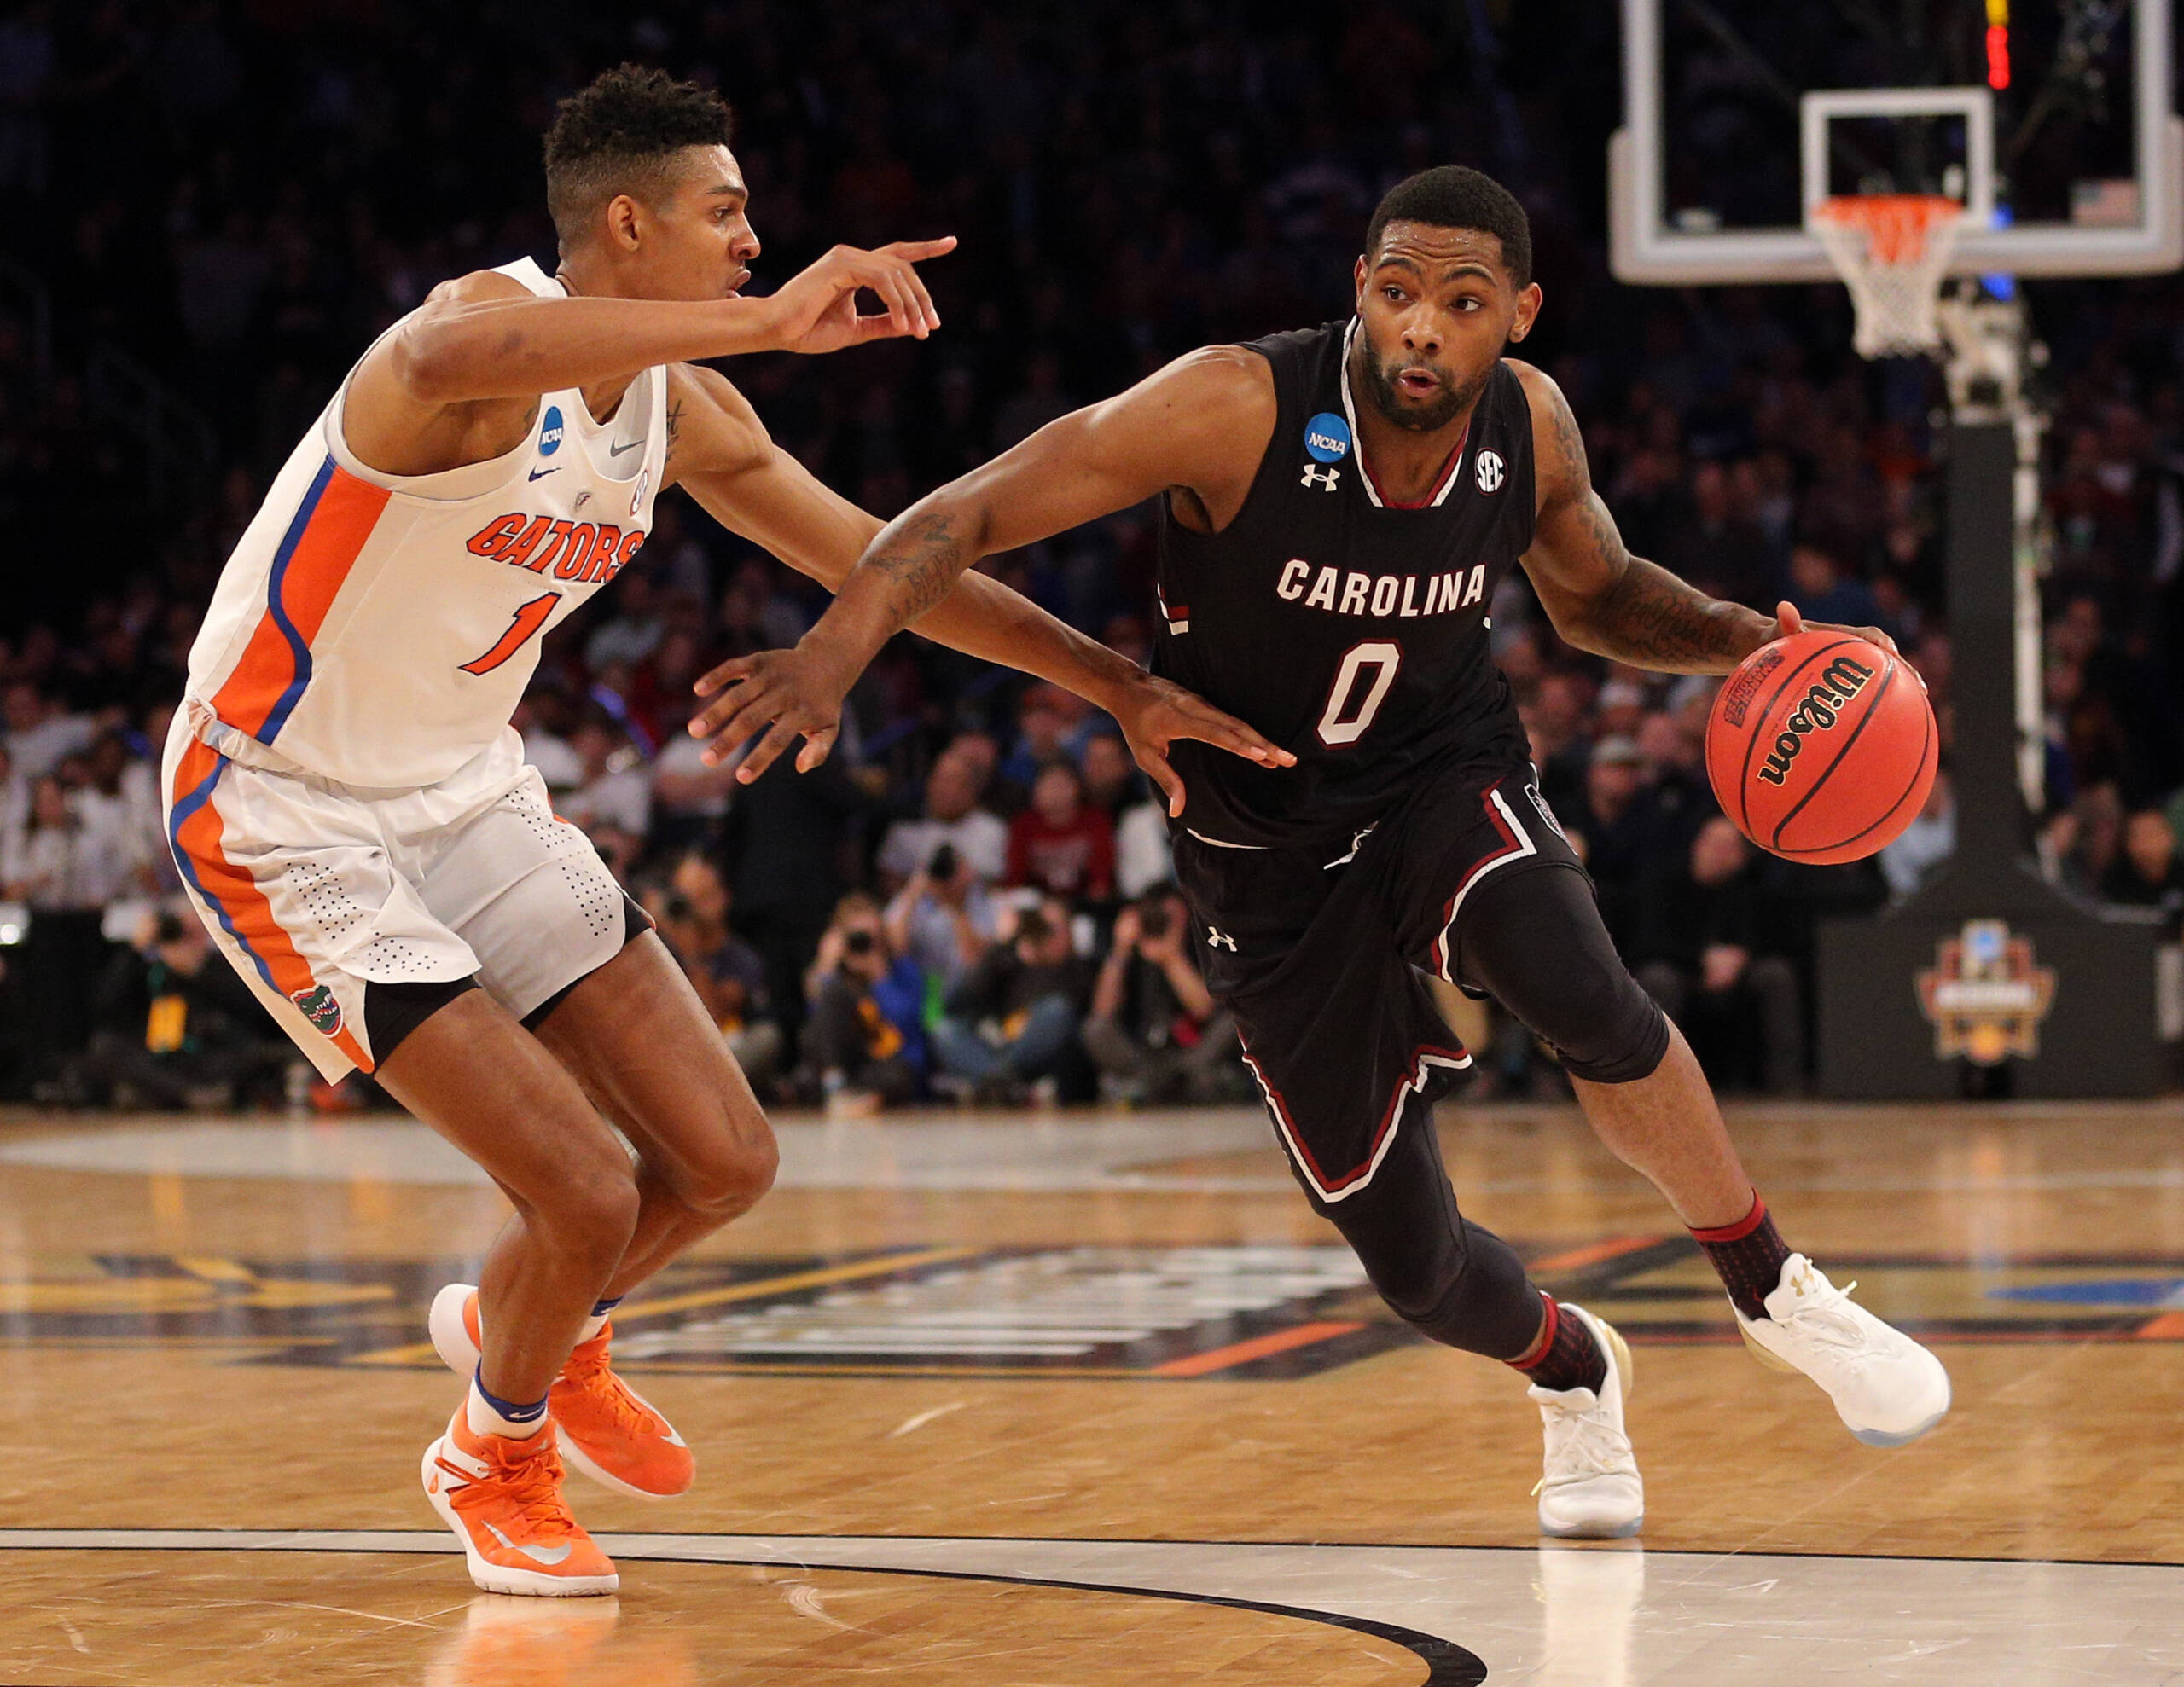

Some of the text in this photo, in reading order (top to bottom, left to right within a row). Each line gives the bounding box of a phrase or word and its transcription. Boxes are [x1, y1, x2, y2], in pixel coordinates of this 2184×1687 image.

[1308, 432, 1347, 455] NCAA
[1476, 450, 1504, 494] SEC
[466, 512, 645, 583] GATORS
[1276, 558, 1488, 618] CAROLINA
[456, 591, 563, 676] 1
[1316, 640, 1402, 749] 0
[1757, 656, 1876, 786] Wilson
